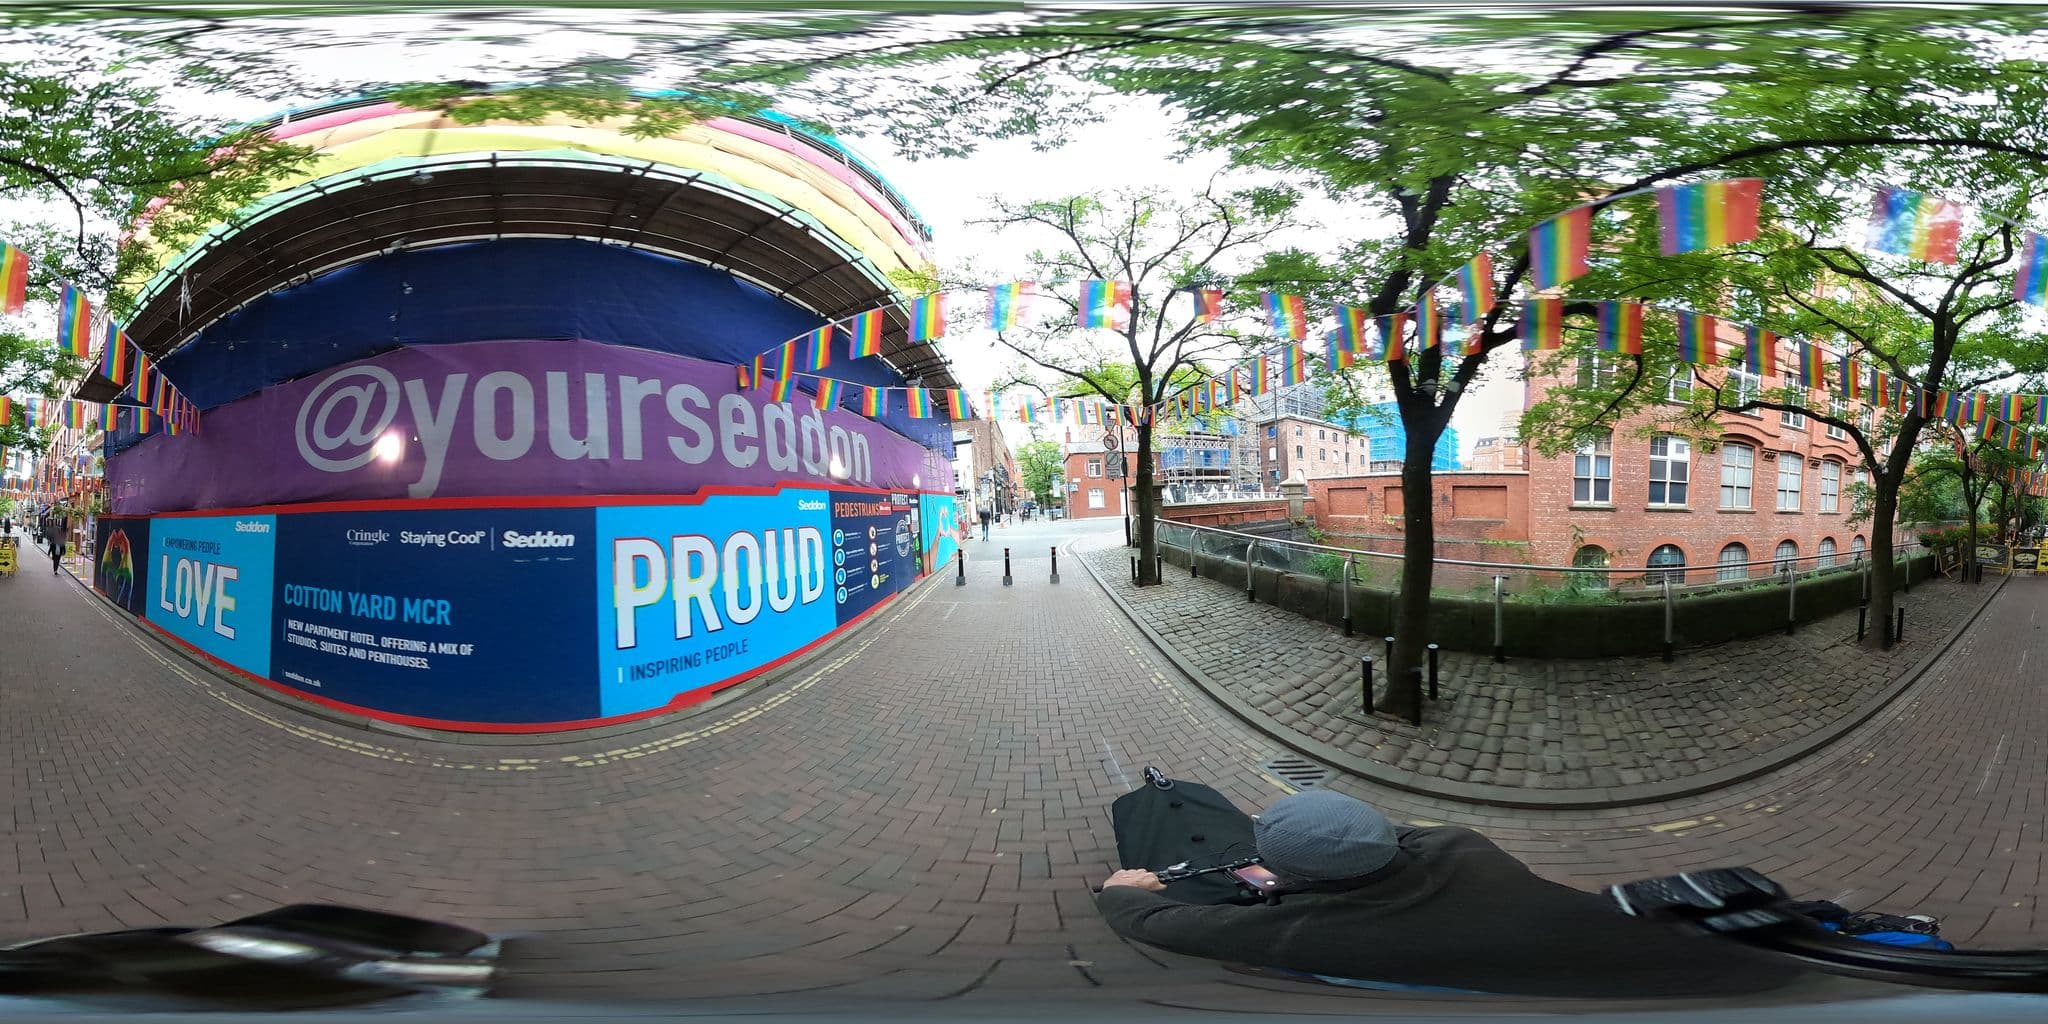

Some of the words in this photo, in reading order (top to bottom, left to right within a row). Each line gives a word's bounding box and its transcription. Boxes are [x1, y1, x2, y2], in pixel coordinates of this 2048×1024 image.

[295, 364, 872, 498] @yourseddon
[798, 500, 827, 511] Seddon
[835, 502, 880, 518] PEDESTRIANS
[235, 520, 270, 533] Seddon
[346, 529, 390, 544] Cringle
[199, 541, 221, 555] PEOPLE
[400, 531, 446, 547] Staying
[503, 530, 575, 548] Seddon
[160, 553, 239, 640] LOVE
[613, 526, 825, 650] PROUD
[284, 583, 343, 614] COTTON
[348, 591, 397, 621] YARD
[403, 597, 452, 626] MCR
[287, 619, 304, 632] NEW
[304, 623, 349, 642] APARTMENT
[380, 636, 427, 653] OFFERING
[427, 642, 437, 653] A
[438, 643, 459, 655] MIX
[461, 643, 475, 656] OF
[319, 641, 348, 656] SUITES
[348, 647, 367, 661] AND
[368, 650, 432, 670] PENTHOUSES.
[630, 651, 702, 681] INSPIRING
[705, 638, 749, 665] PEOPLE
